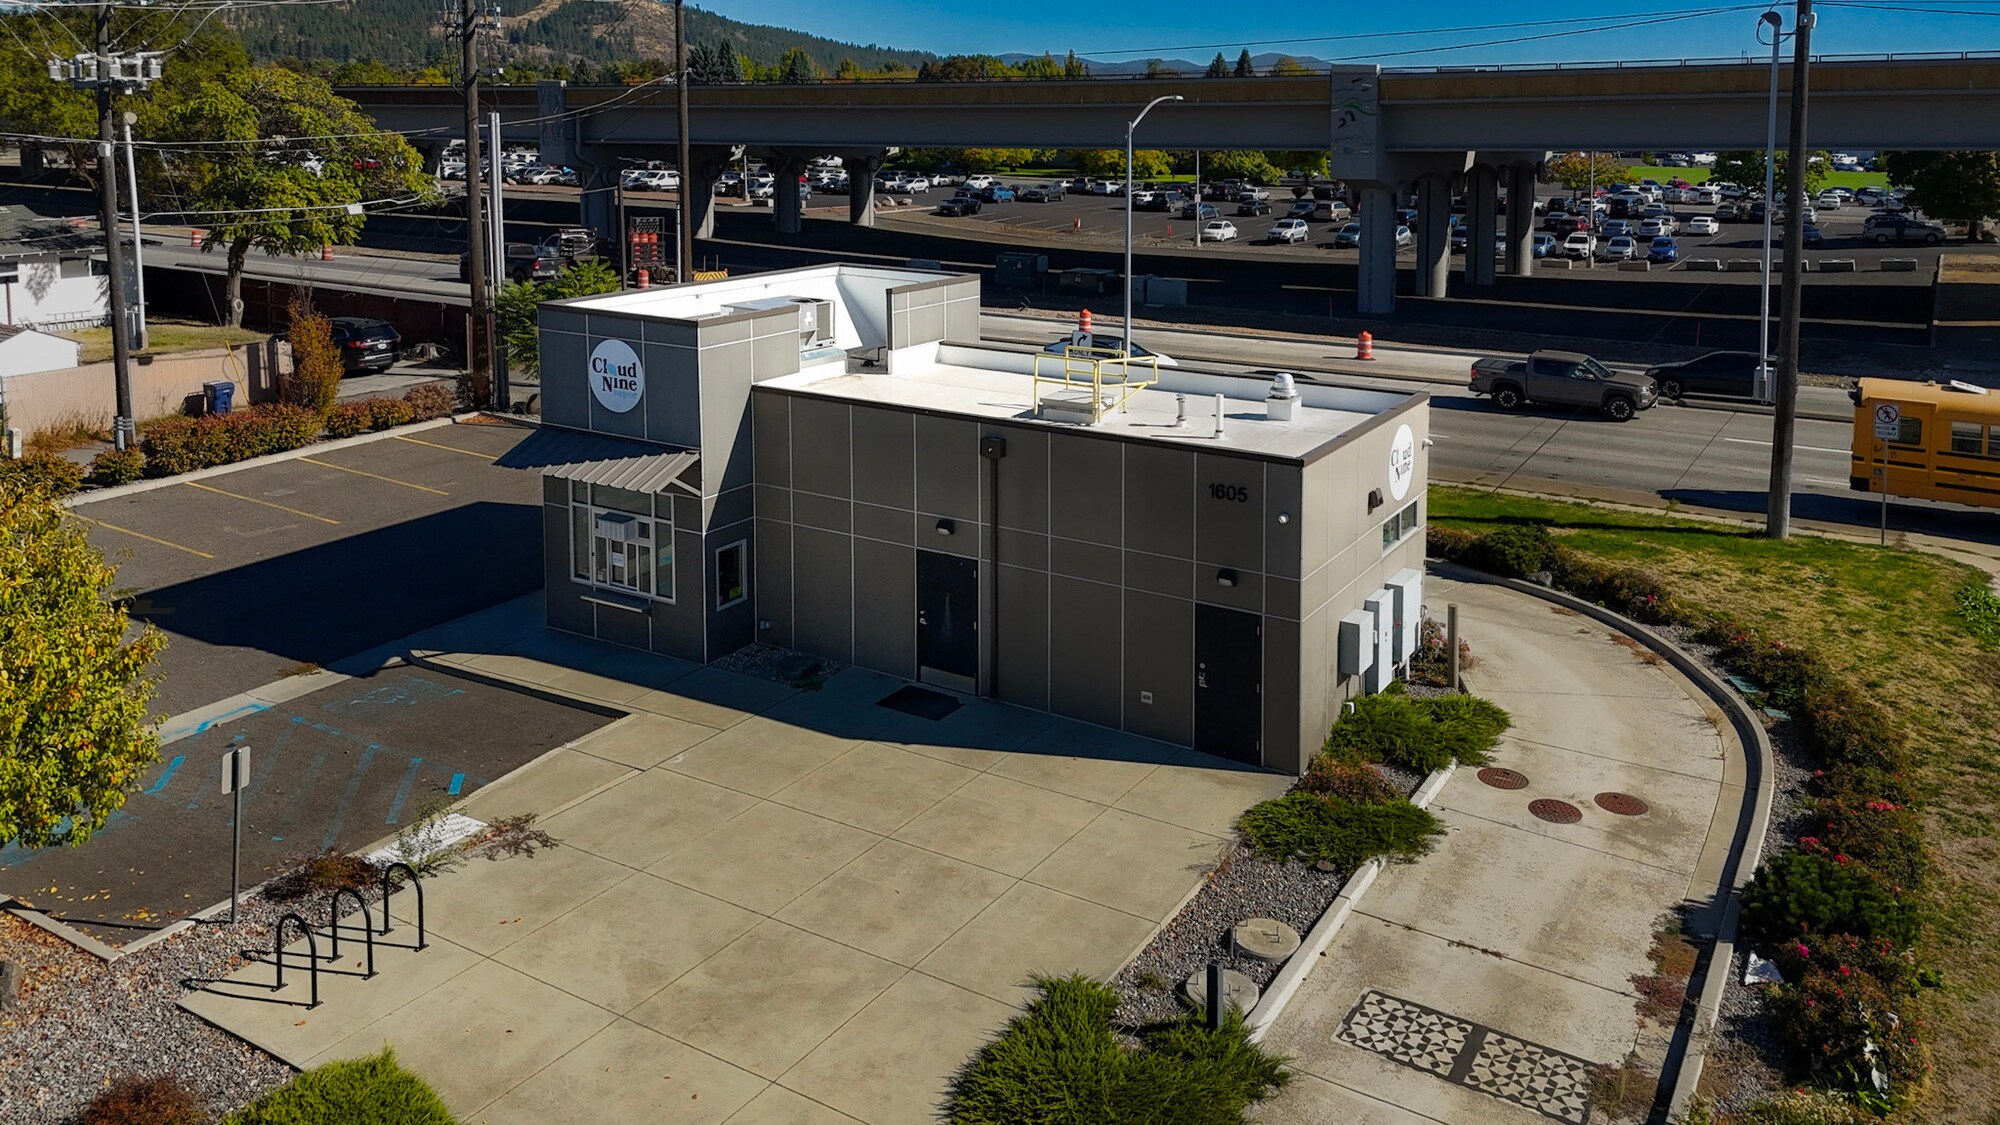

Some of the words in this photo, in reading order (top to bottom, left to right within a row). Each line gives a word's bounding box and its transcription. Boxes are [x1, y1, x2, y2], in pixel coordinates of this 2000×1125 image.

[1074, 349, 1090, 357] ONLY
[592, 357, 637, 378] Cloud
[602, 376, 637, 392] Nine
[1391, 442, 1411, 466] Clud
[1208, 483, 1248, 503] 1605
